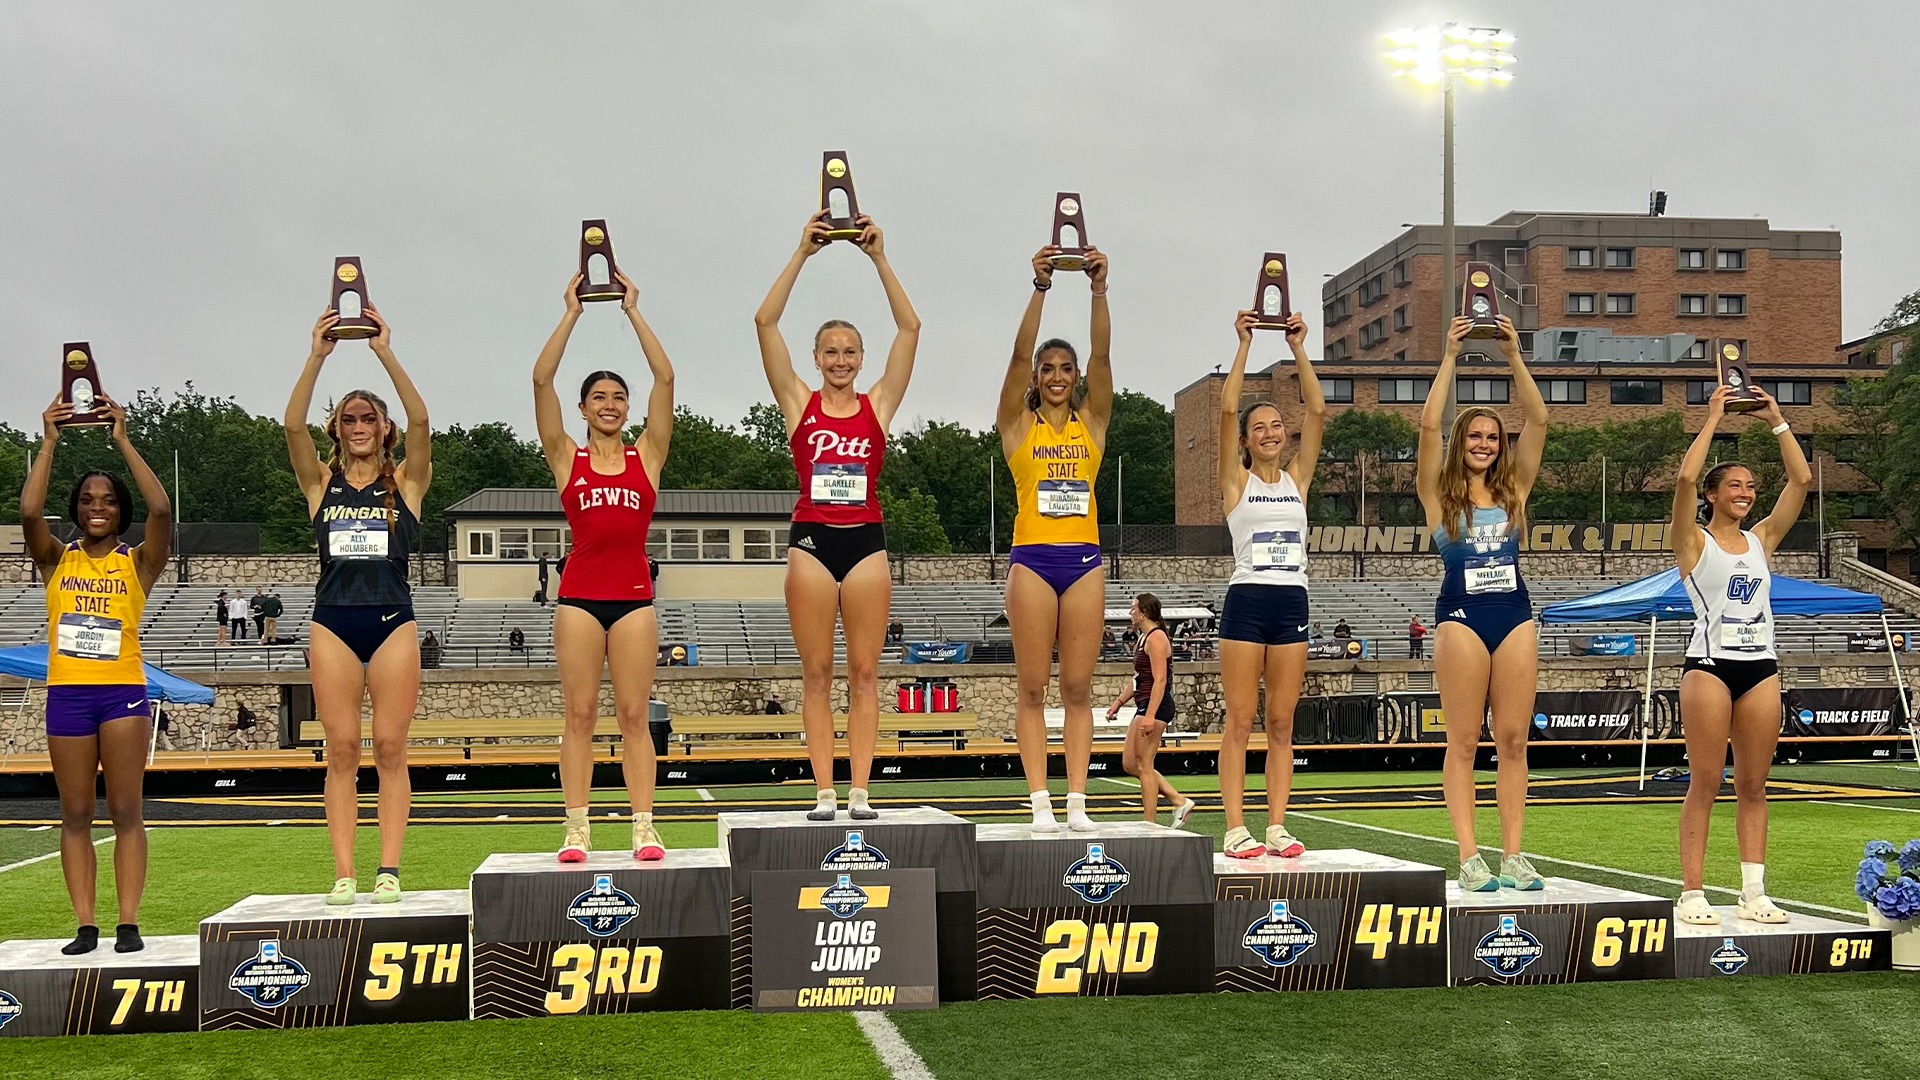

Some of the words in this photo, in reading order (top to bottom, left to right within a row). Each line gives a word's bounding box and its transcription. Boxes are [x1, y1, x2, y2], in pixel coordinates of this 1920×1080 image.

[807, 429, 872, 462] Pitt
[1032, 444, 1091, 460] MINNESOTA
[1047, 462, 1078, 478] STATE
[823, 479, 856, 488] BLAKELEE
[578, 487, 641, 511] LEWIS
[322, 505, 400, 522] WINGATE
[350, 534, 367, 543] ALLY
[1465, 536, 1509, 544] WASHBURN
[1611, 523, 1673, 550] FIEL
[340, 544, 379, 553] HOLMBERG
[1271, 555, 1287, 563] BEST
[60, 575, 128, 596] MINNESOTA
[1727, 574, 1763, 605] GV
[75, 595, 111, 614] STATE
[74, 630, 105, 642] JORDIN
[75, 641, 102, 652] MCGEE
[1550, 714, 1585, 728] TRACK
[1588, 714, 1596, 727] &
[1600, 713, 1629, 727] FIELD
[1815, 711, 1849, 724] TRACK
[1851, 710, 1859, 723] &
[1861, 709, 1890, 723] FIELD
[215, 779, 236, 787] GILL
[822, 862, 888, 871] CHAMPIONSHIPS
[1065, 874, 1128, 884] CHAMPIONSHIPS
[820, 896, 868, 904] CHAMPIONSHIPS
[569, 906, 637, 917] CHAMPIONSHIPS
[815, 920, 877, 946] LONG
[1244, 934, 1315, 945] CHAMPIONSHIPS
[1354, 903, 1443, 960] 4TH
[1591, 917, 1667, 967] 6TH
[810, 946, 881, 972] JUMP
[1035, 919, 1160, 994] 2ND
[1476, 946, 1541, 957] CHAMPIONSHIPS
[1829, 937, 1873, 967] 8TH
[363, 941, 463, 1001] 5TH
[544, 943, 663, 1015] 3RD
[231, 974, 308, 987] CHAMPIONSHIPS
[828, 976, 865, 986] WOMEN'S
[110, 978, 186, 1026] 7TH
[797, 985, 896, 1008] CHAMPION
